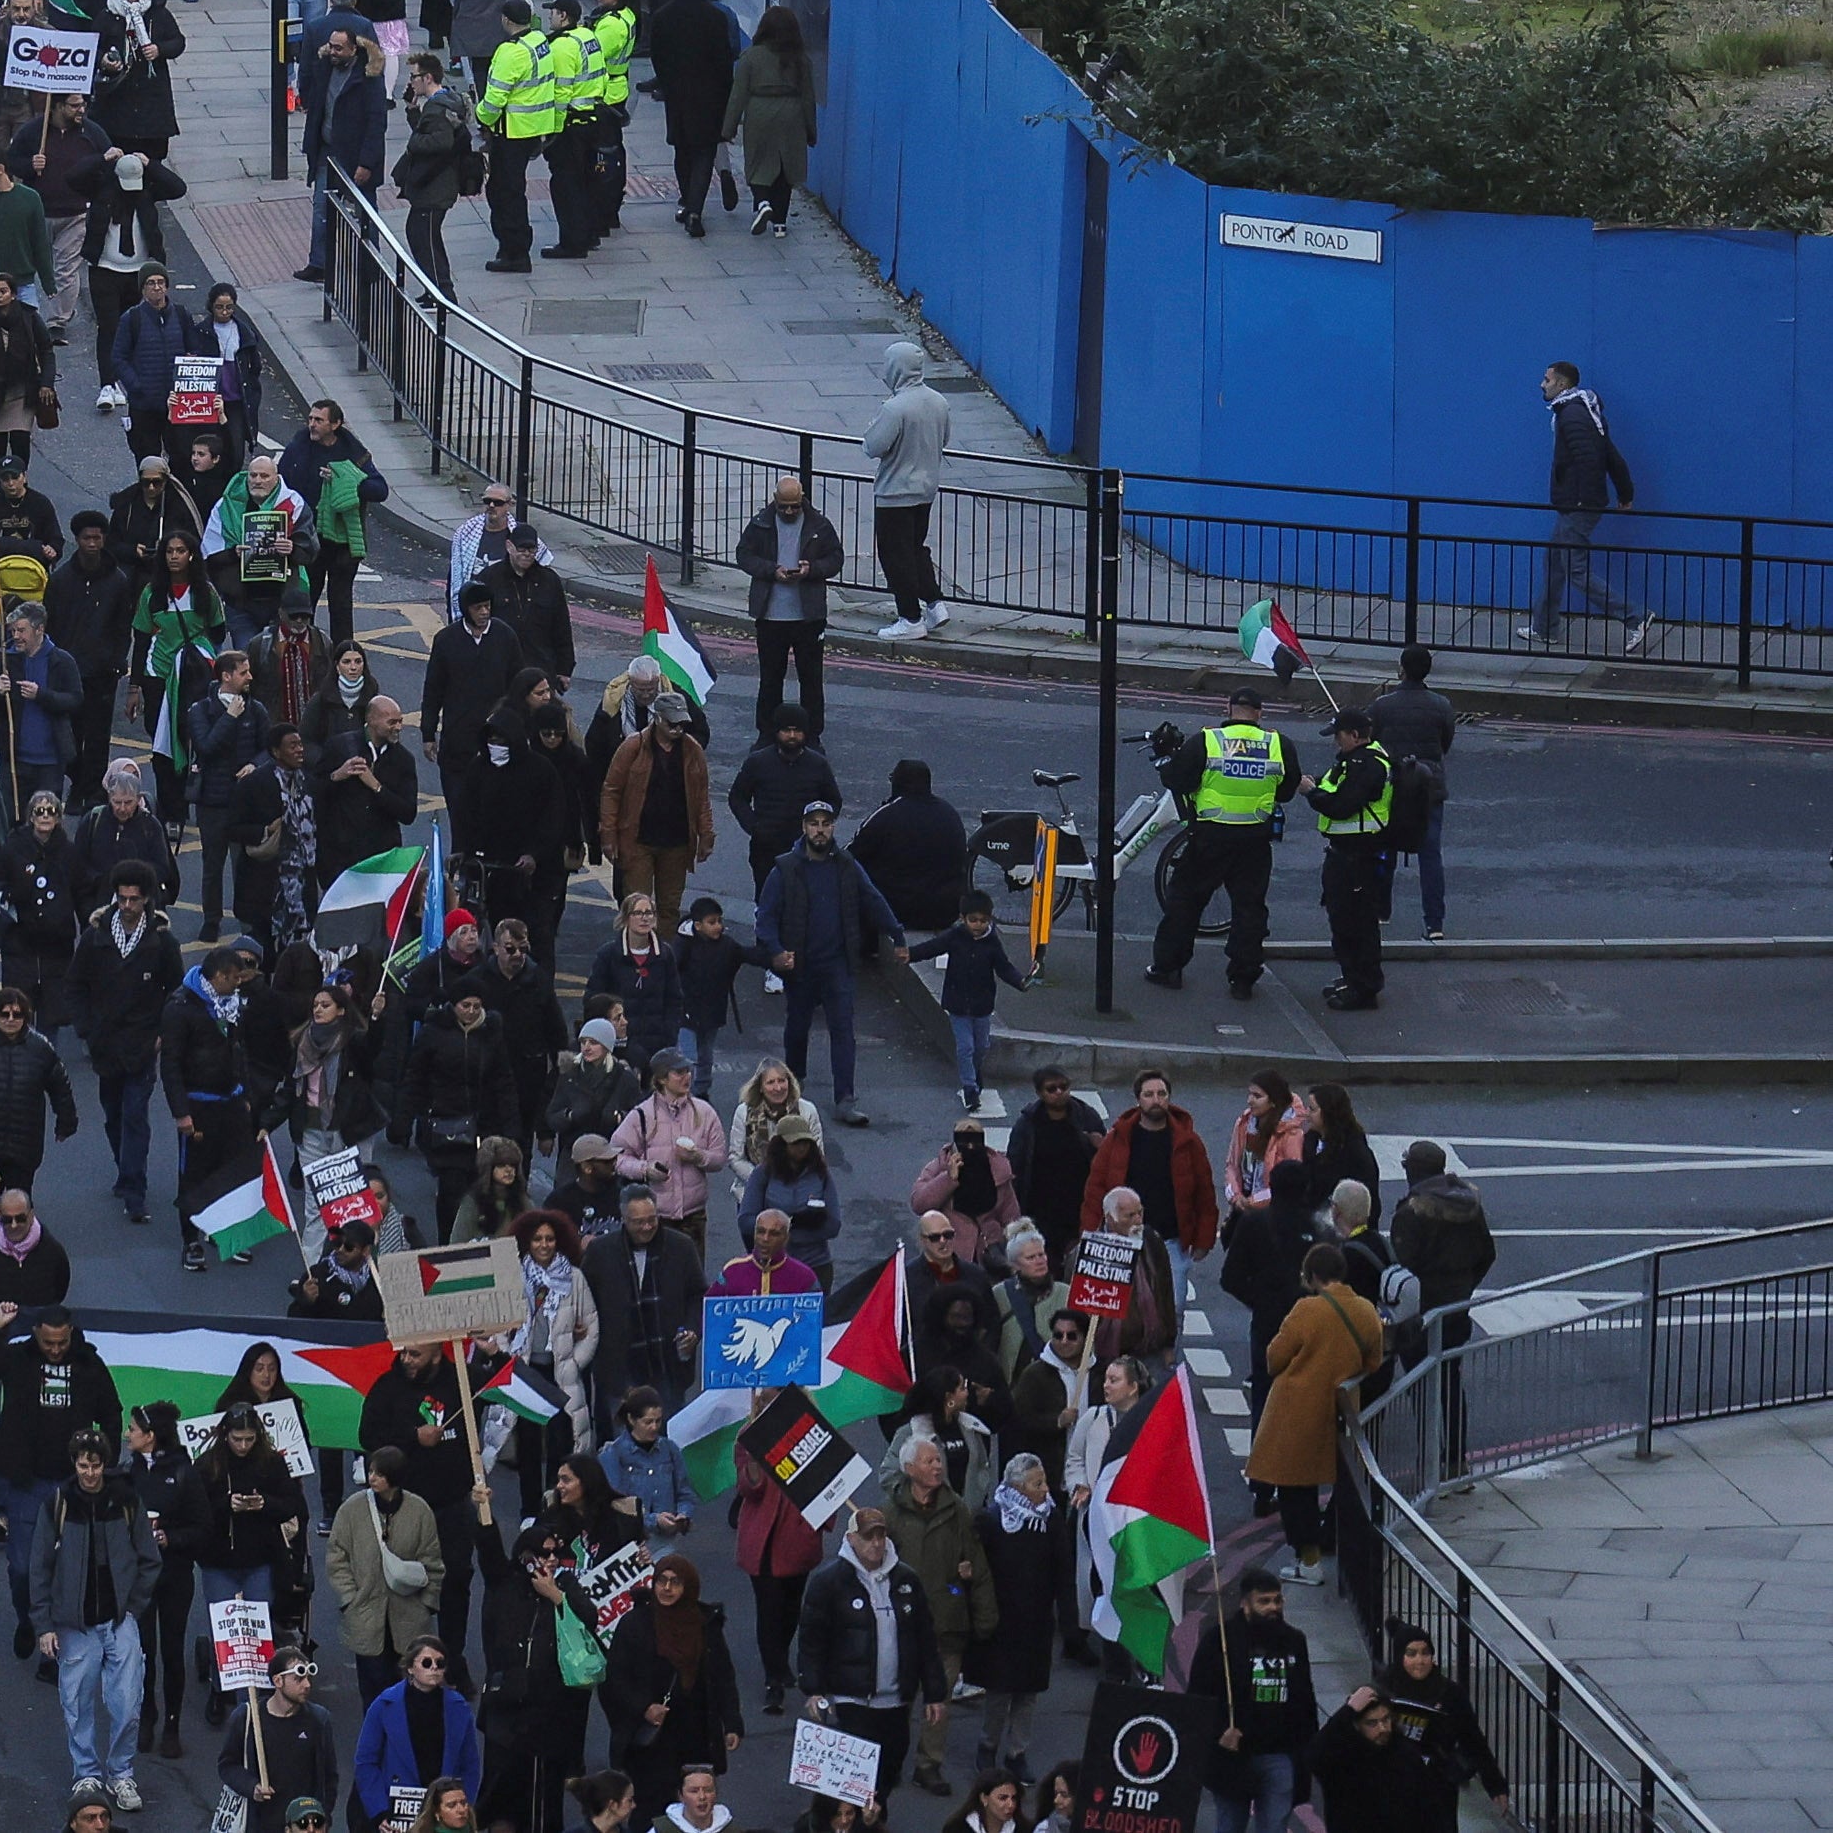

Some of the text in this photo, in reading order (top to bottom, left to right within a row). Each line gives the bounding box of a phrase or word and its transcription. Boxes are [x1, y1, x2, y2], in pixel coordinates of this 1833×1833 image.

[13, 37, 91, 69] Gaza
[10, 66, 87, 82] Stop the massacre
[1231, 222, 1349, 252] PONTON ROAD
[177, 365, 217, 376] FREEDOM
[174, 380, 217, 393] PALESTINE
[1224, 758, 1265, 778] POLICE
[1123, 822, 1162, 861] Lime
[312, 1160, 360, 1189] FREEDOM
[316, 1175, 369, 1207] PALESTINE
[1084, 1243, 1134, 1264] FREEDOM
[1077, 1262, 1132, 1284] PALESTINE
[714, 1296, 823, 1318] CEASEFIRE NOW
[775, 1459, 795, 1481] ON
[791, 1427, 832, 1467] ISRAEL
[218, 1618, 267, 1630] STOP THE WAR
[229, 1626, 259, 1638] ON GAZA!
[802, 1728, 877, 1760] CRUELLA
[793, 1768, 840, 1789] STOP THE
[798, 1754, 870, 1783] STOP THE HATE
[1112, 1785, 1160, 1811] STOP
[1085, 1811, 1181, 1833] BLOODSHED
